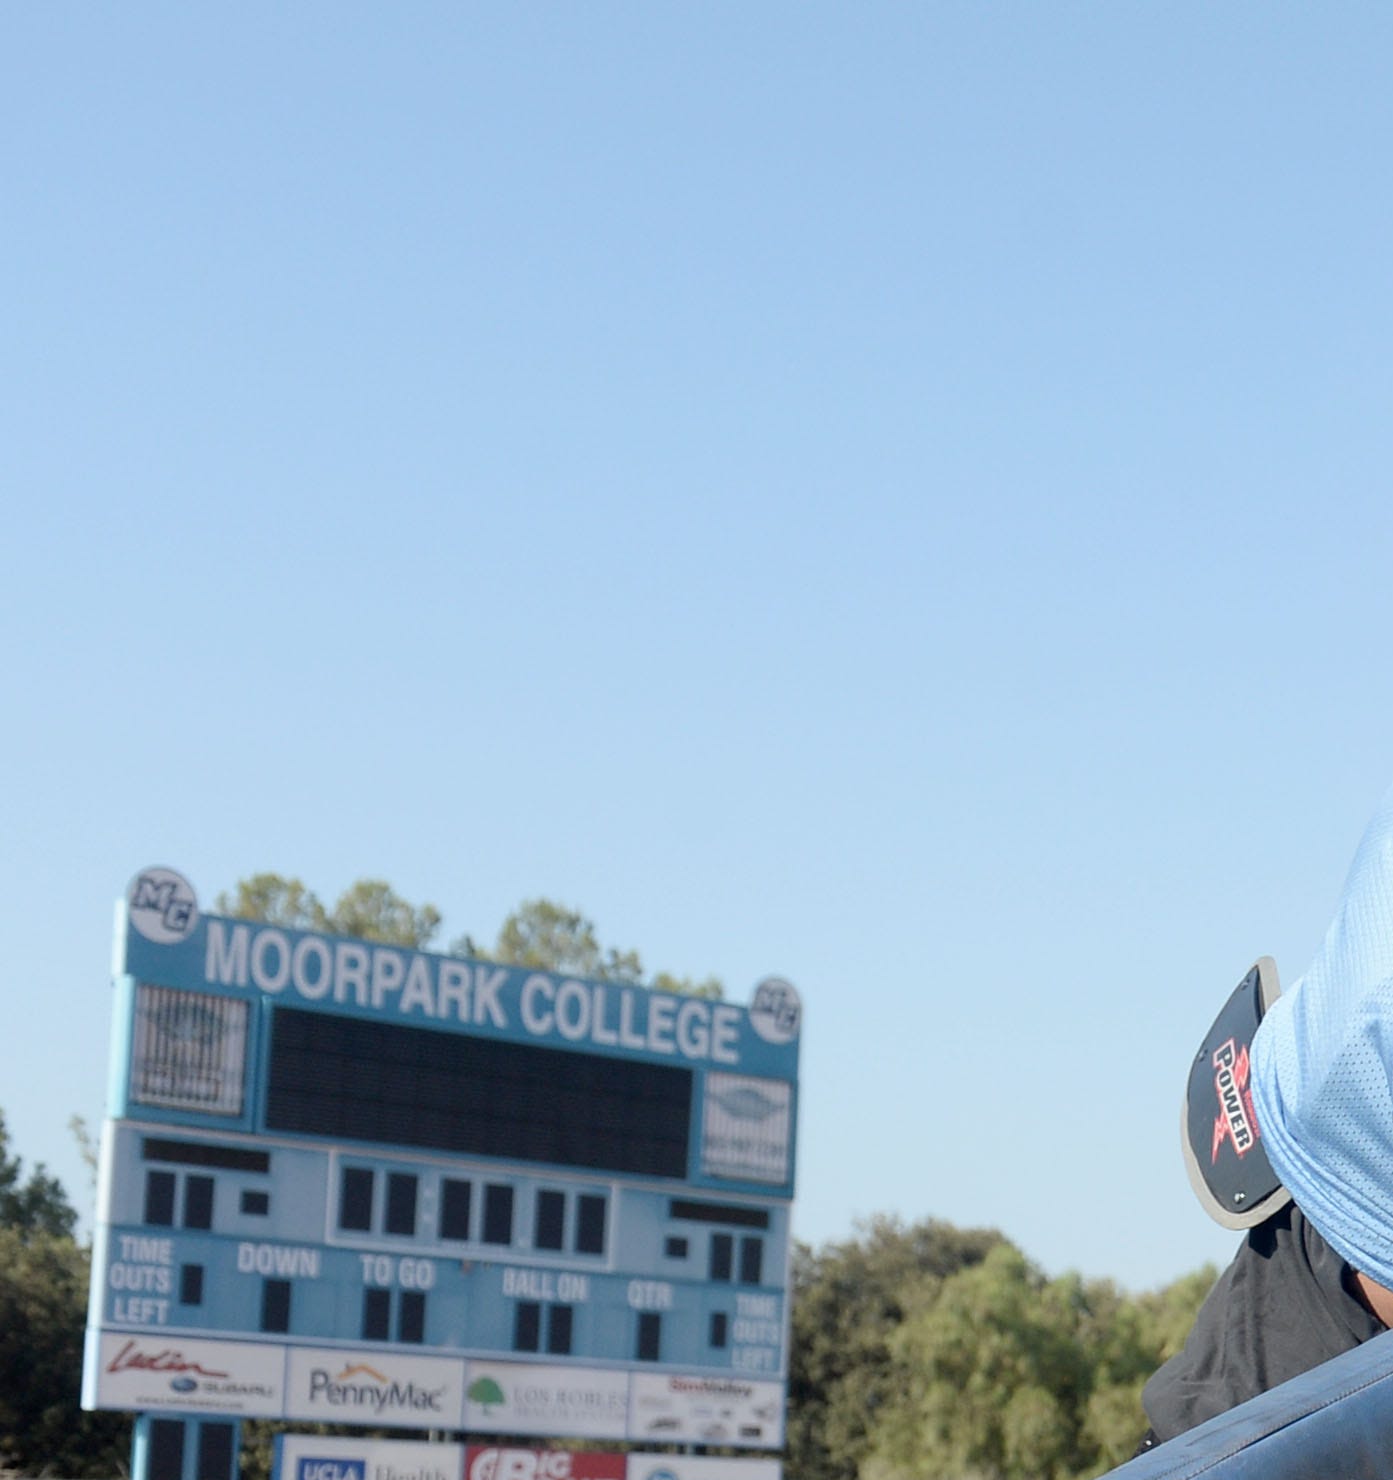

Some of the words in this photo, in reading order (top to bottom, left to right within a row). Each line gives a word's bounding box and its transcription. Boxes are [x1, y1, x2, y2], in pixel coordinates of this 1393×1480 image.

[205, 920, 511, 1029] MOORPARK
[520, 974, 741, 1064] COLLEGE
[1216, 1043, 1252, 1150] POWER
[121, 1235, 174, 1264] TIME
[237, 1242, 321, 1278] DOWN
[110, 1263, 171, 1294] OUTS
[359, 1254, 392, 1286] TO
[399, 1258, 436, 1290] GO
[503, 1268, 554, 1298] BALL
[557, 1275, 589, 1301] ON
[113, 1296, 169, 1325] LEFT
[627, 1280, 675, 1310] QTR
[309, 1368, 442, 1412] PennyMac
